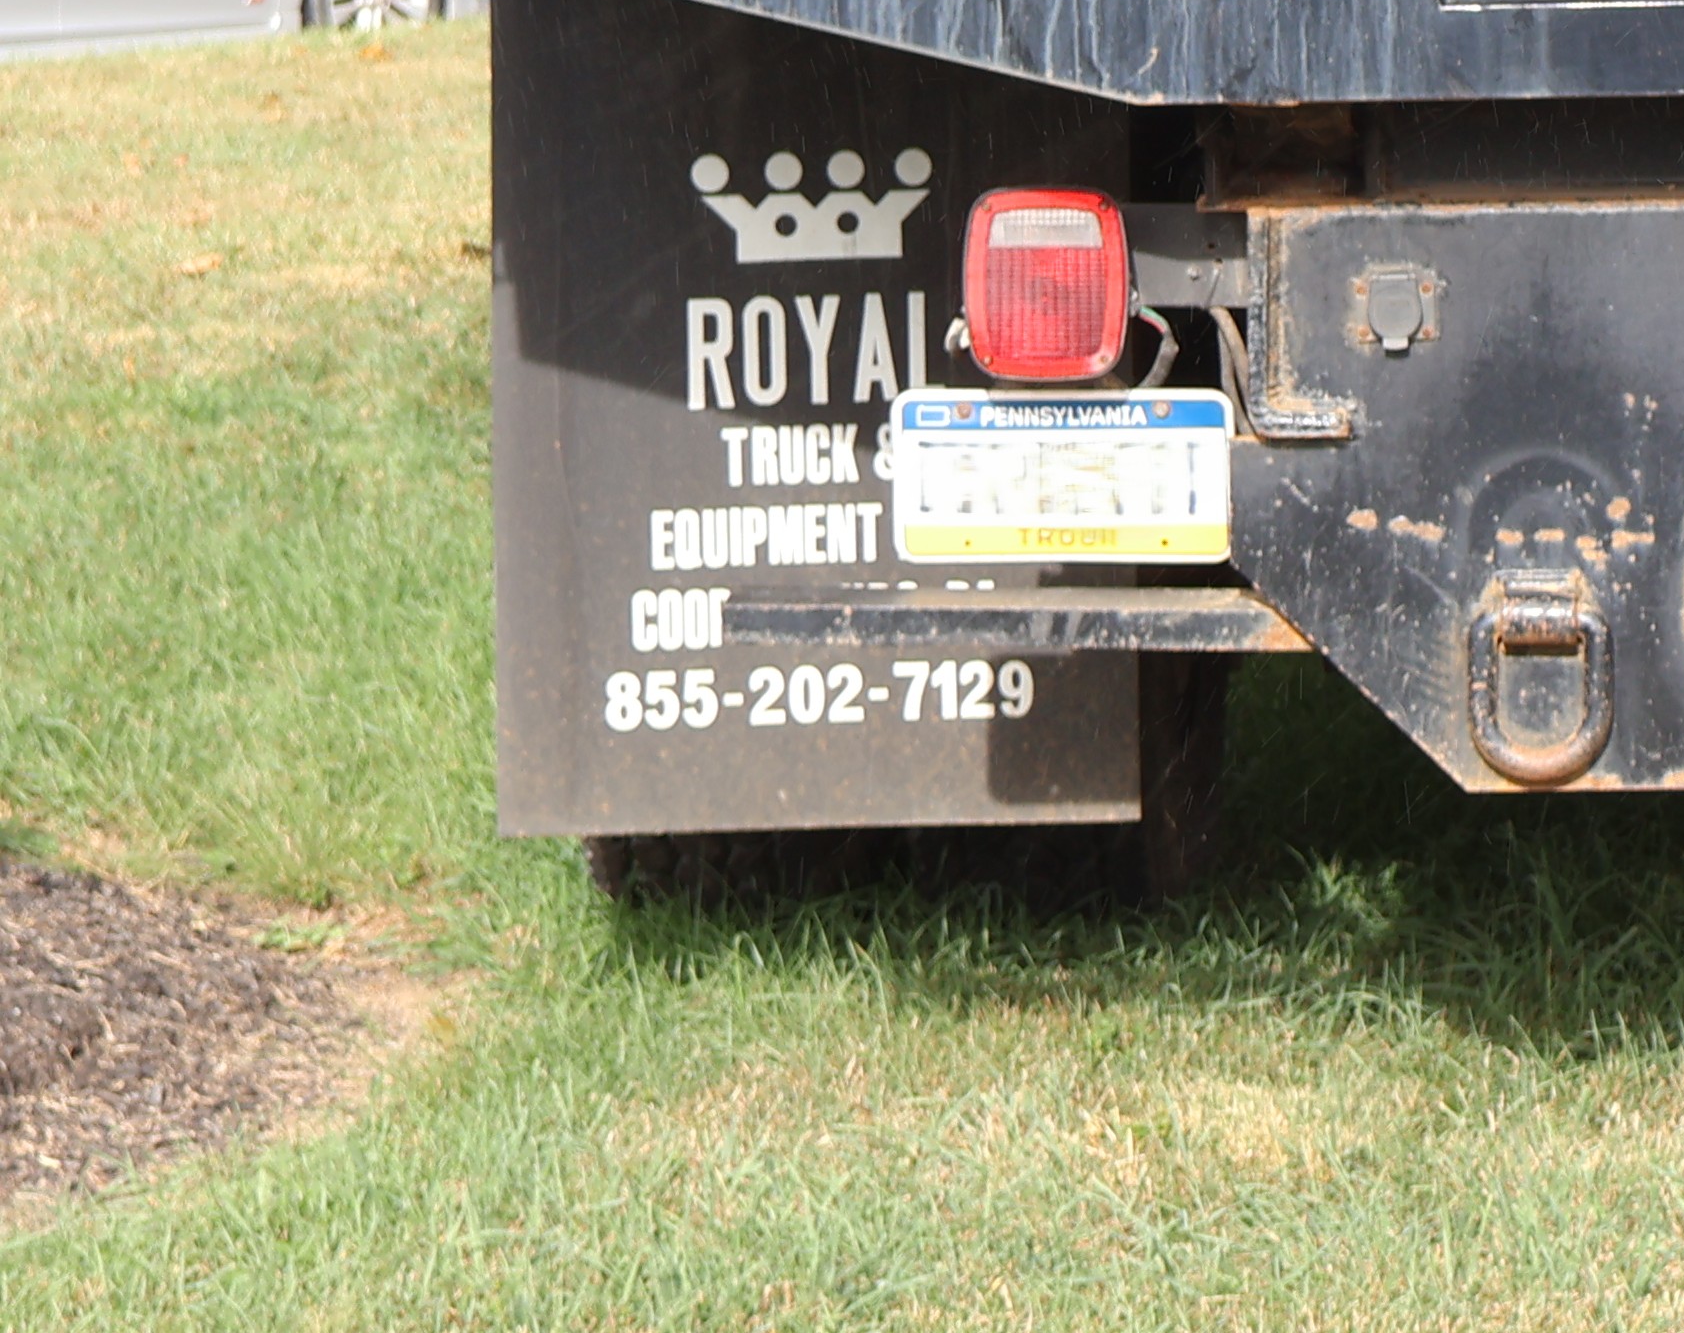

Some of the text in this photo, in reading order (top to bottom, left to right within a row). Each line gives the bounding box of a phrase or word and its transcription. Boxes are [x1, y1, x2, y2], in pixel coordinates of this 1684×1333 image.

[686, 290, 945, 410] ROYAL
[980, 405, 1147, 428] PENNSYLVANIA
[720, 423, 860, 487] TRUCK
[651, 501, 883, 571] EQUIPMENT
[604, 660, 1035, 732] 855-202-7129
